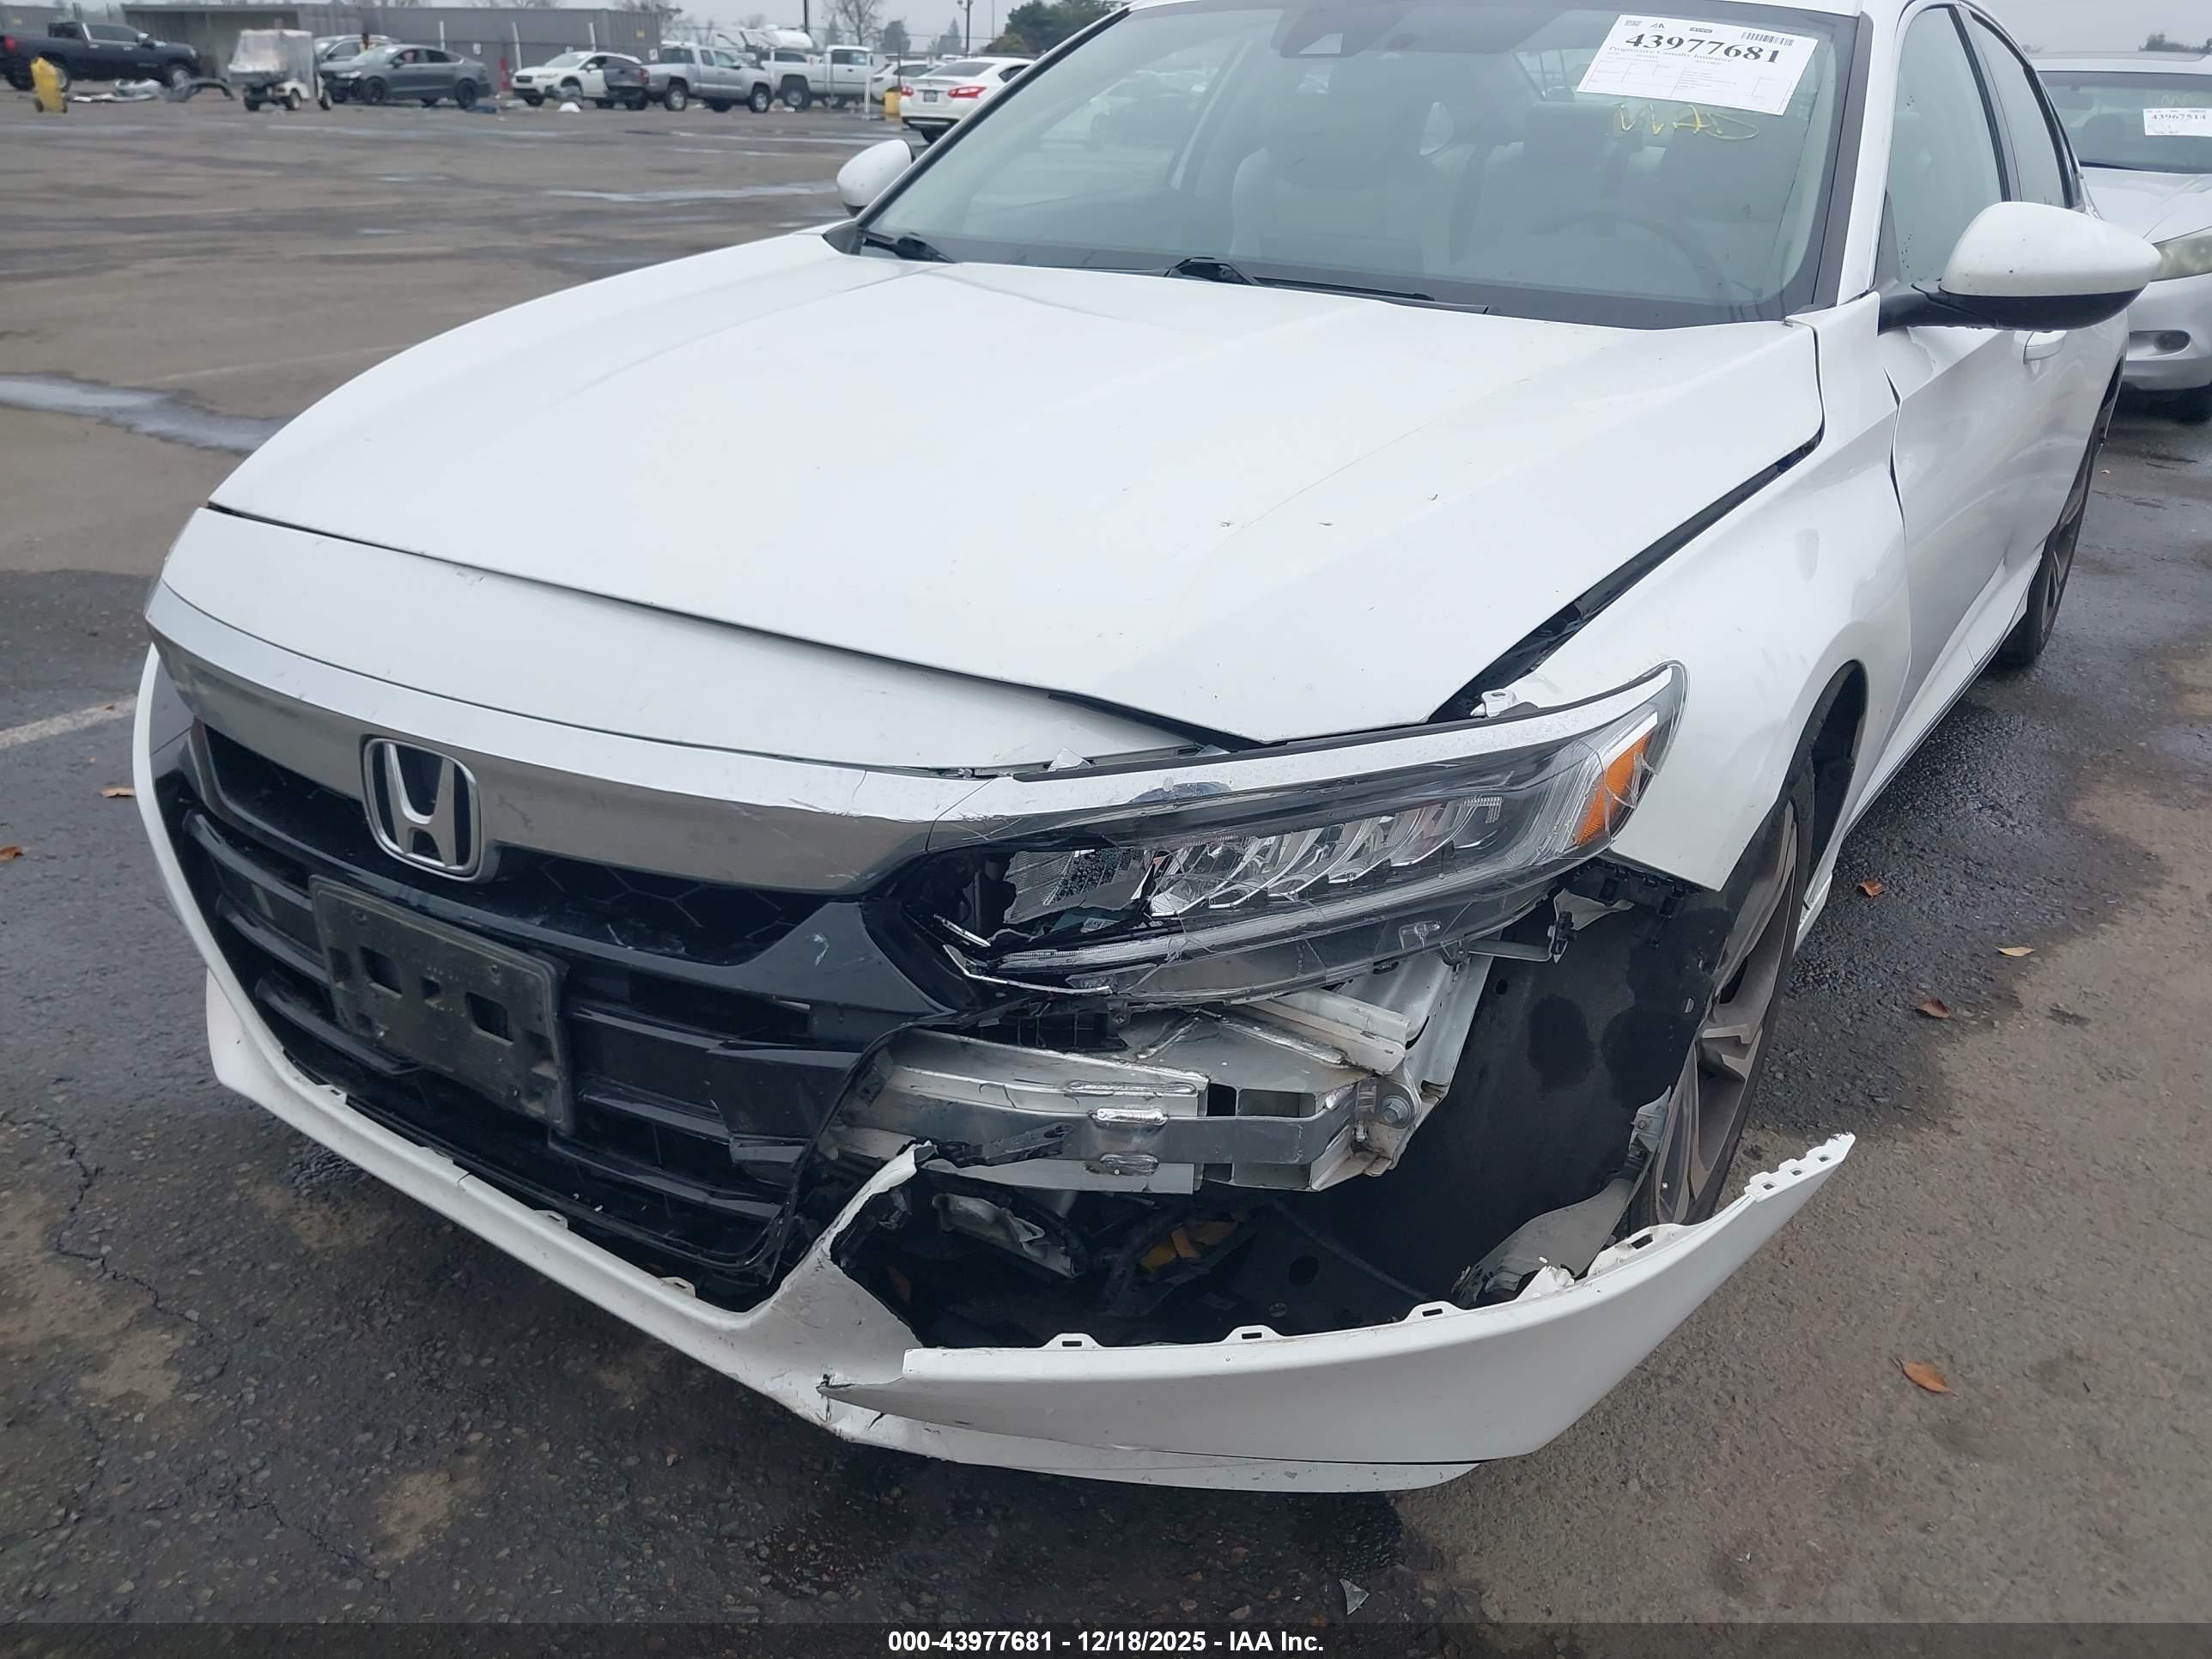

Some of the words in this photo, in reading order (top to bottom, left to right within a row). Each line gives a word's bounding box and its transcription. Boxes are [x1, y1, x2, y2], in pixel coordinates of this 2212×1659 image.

[1608, 46, 1656, 56] Progressive
[1656, 49, 1691, 59] Casualty
[1693, 53, 1734, 64] Insurance
[1626, 33, 1780, 64] 43977681
